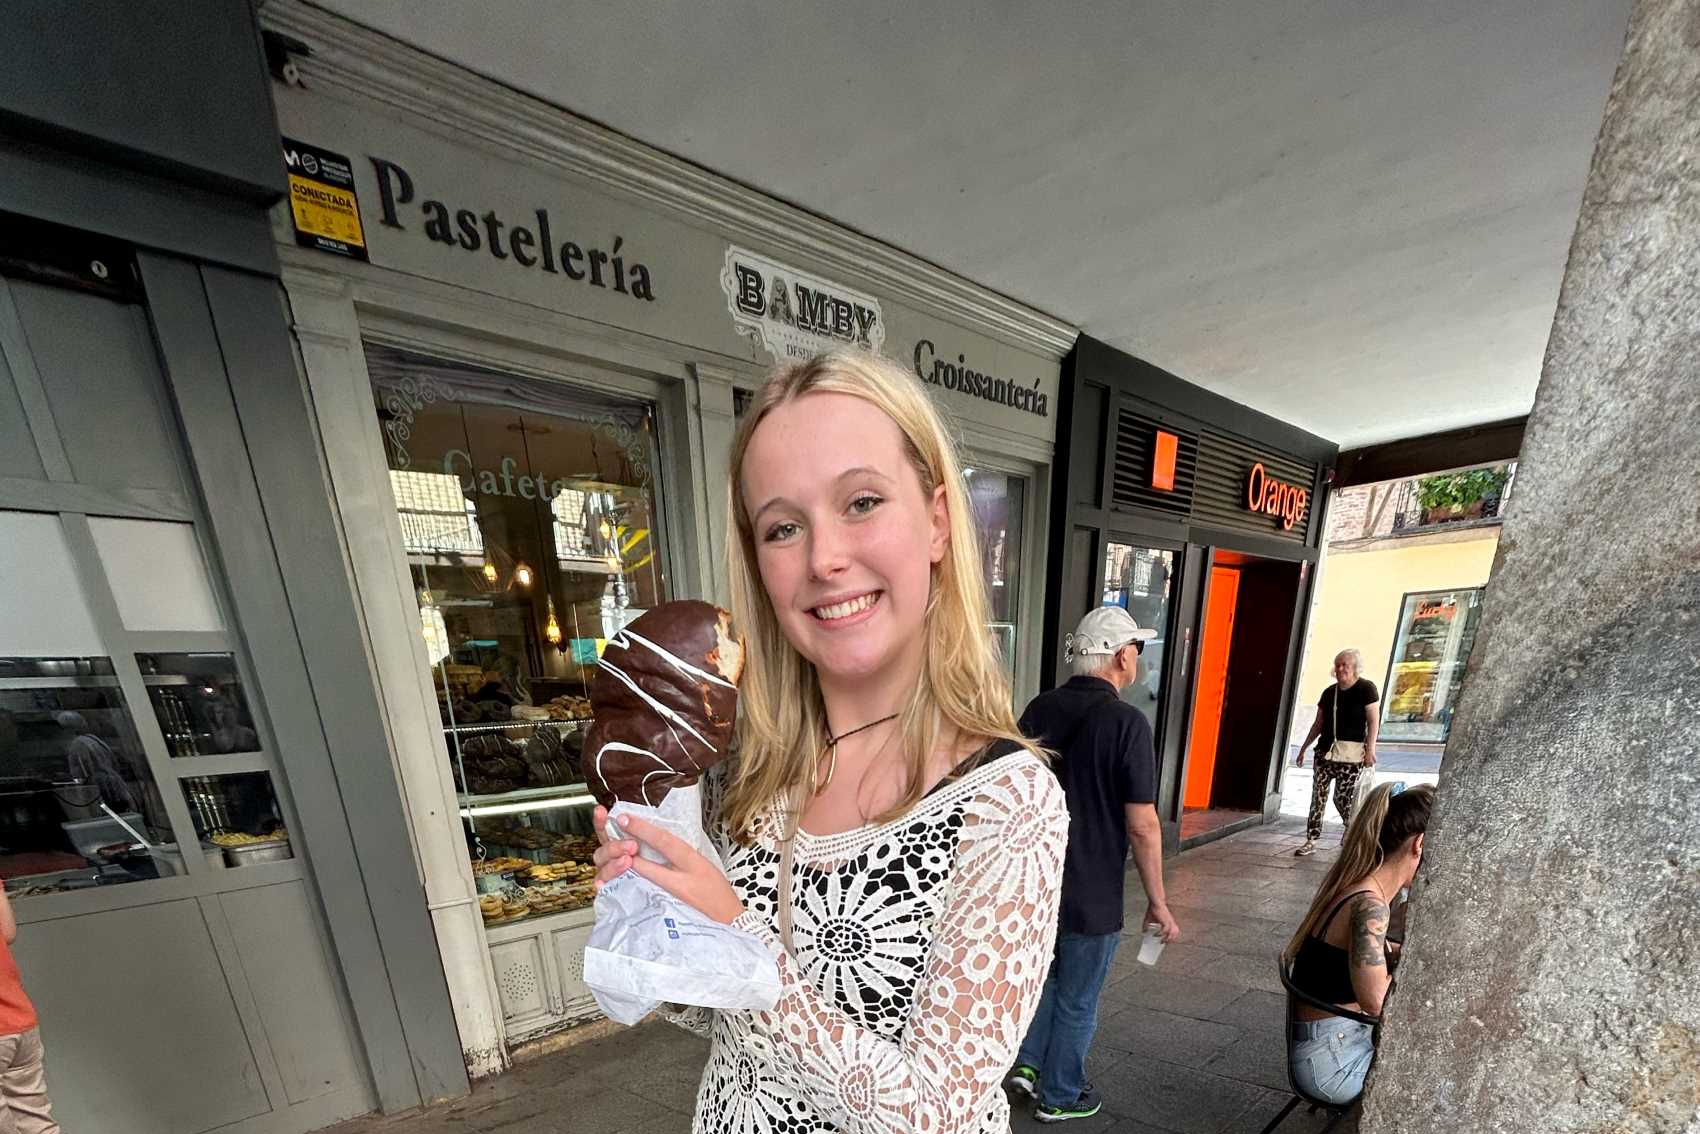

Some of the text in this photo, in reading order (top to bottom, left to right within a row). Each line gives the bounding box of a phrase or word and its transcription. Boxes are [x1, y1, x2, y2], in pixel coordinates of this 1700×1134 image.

[291, 183, 354, 209] CONECTADA
[369, 156, 656, 301] Pastelería
[735, 262, 877, 350] BAMBY
[914, 340, 1048, 417] Croissantería
[1248, 462, 1306, 531] Orange
